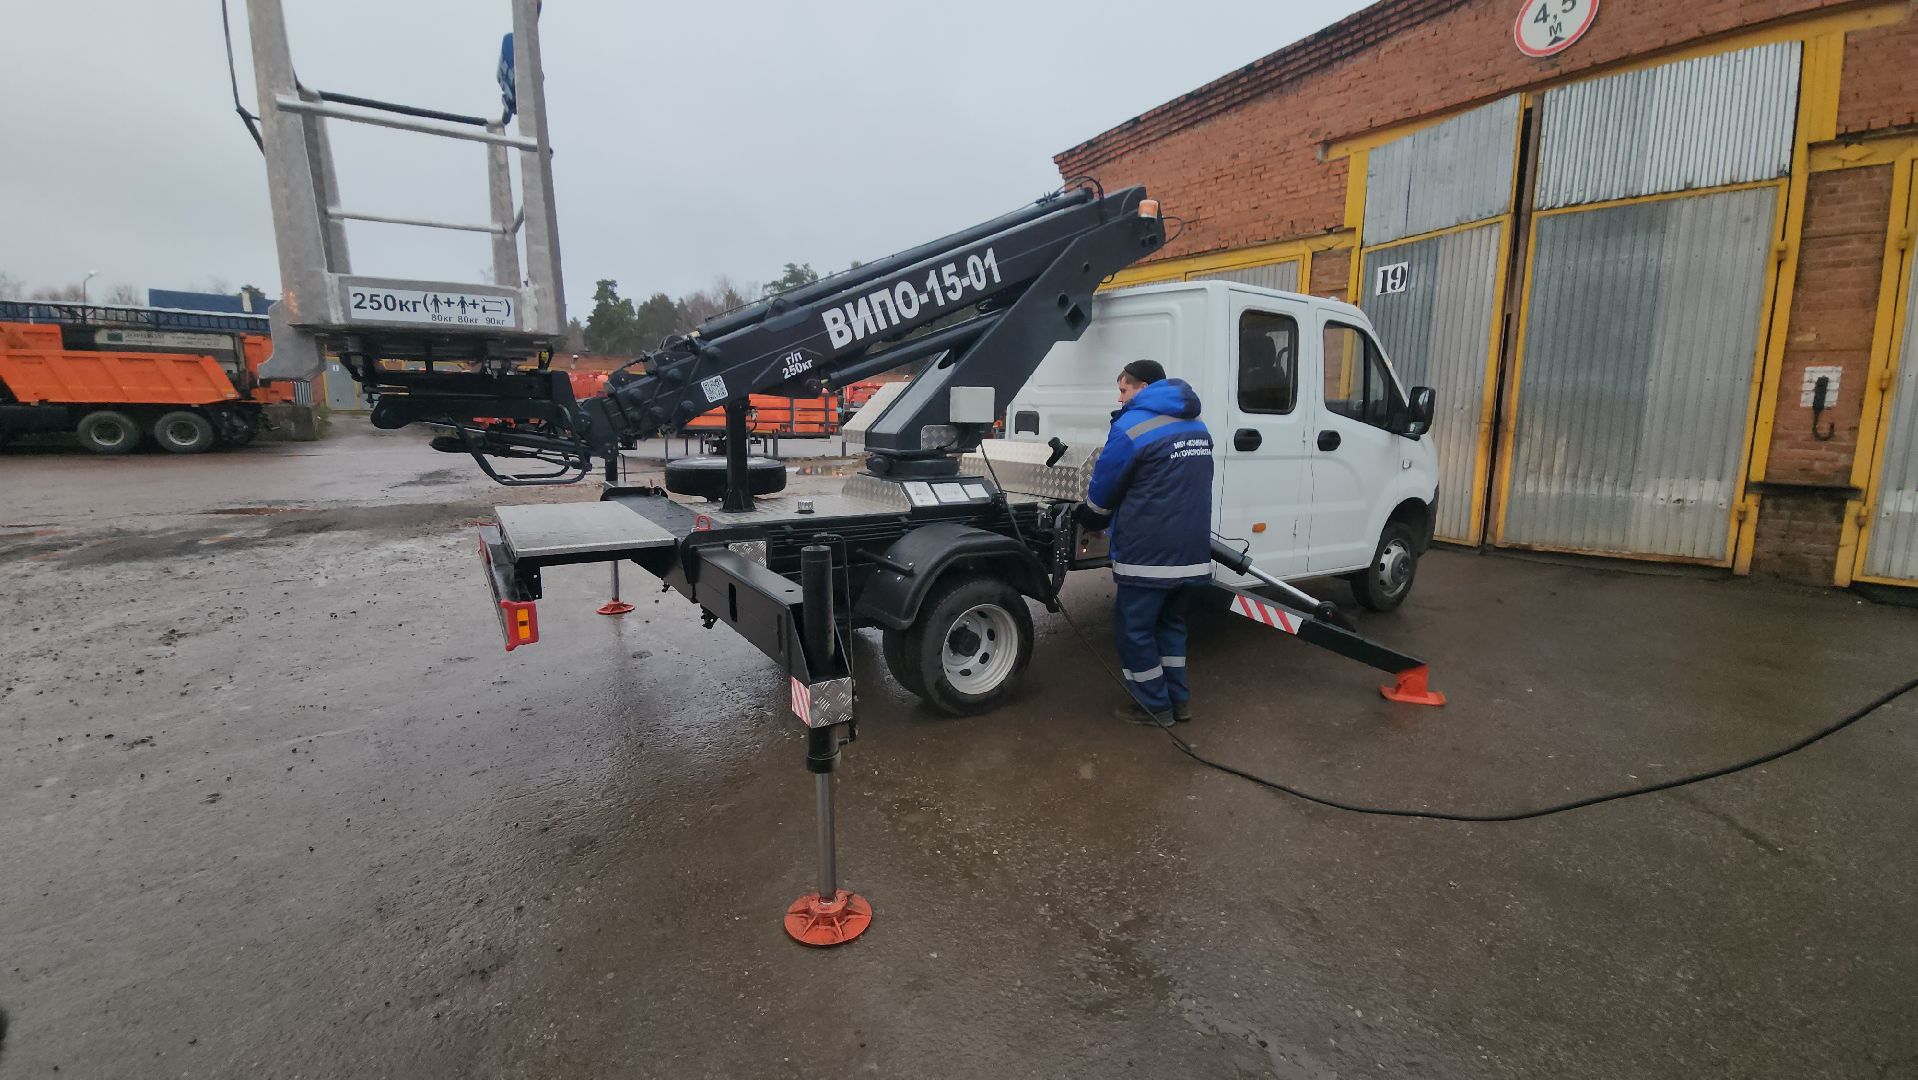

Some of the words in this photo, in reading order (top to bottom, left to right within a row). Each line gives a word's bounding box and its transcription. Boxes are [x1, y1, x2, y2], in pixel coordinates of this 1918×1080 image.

[1534, 0, 1576, 24] 4,5
[1380, 266, 1406, 293] 19
[821, 247, 1002, 350] ВИПО-15-01
[431, 314, 454, 322] 80кг
[457, 316, 479, 324] 80кг
[485, 317, 505, 326] 90кг
[782, 359, 813, 380] 250кг
